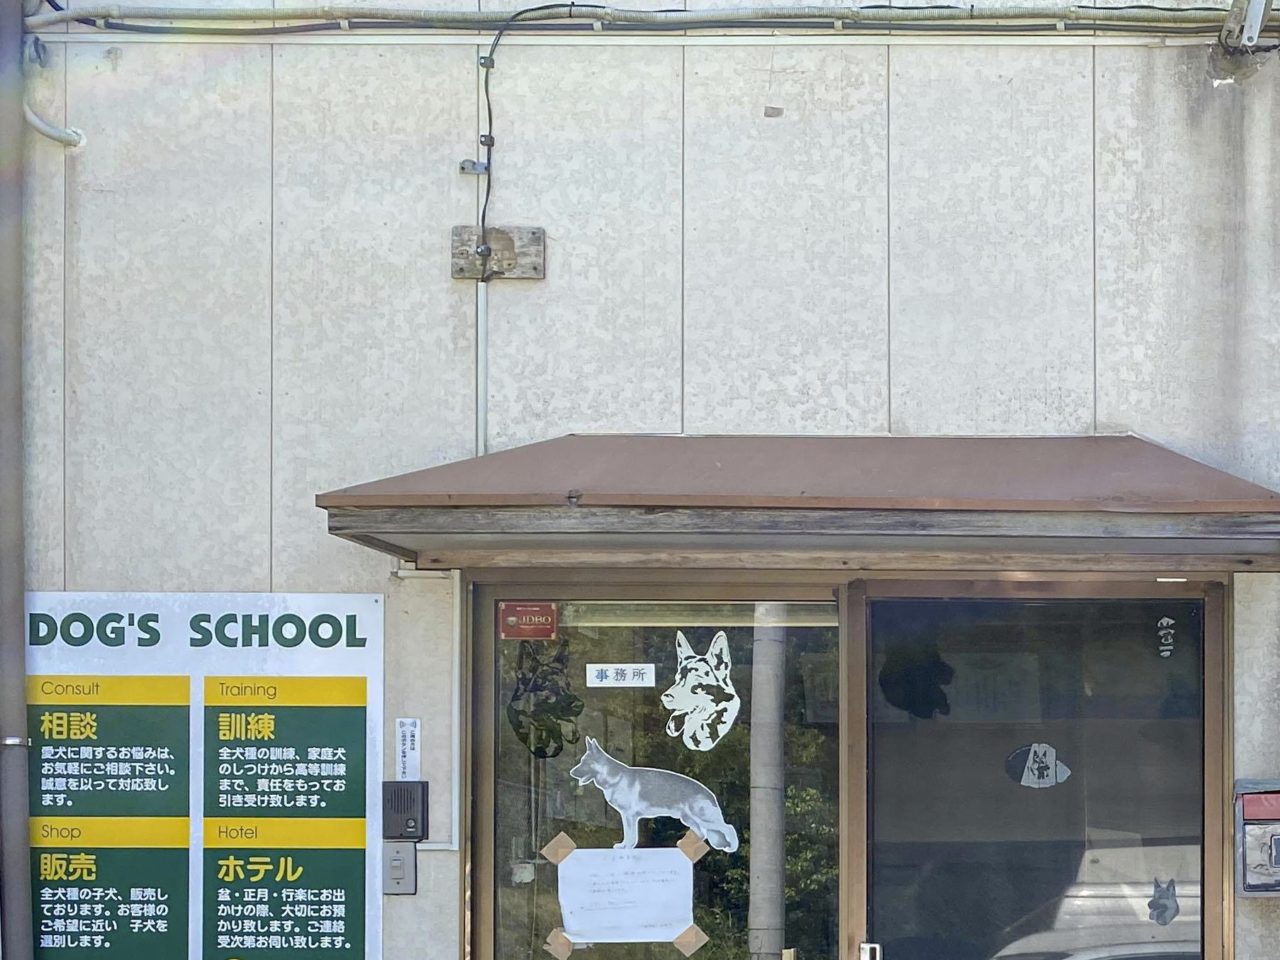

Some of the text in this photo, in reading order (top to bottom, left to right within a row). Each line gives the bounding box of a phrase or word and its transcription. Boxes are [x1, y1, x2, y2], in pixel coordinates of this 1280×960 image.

[29, 613, 367, 648] DOG'S SCHOOL
[595, 668, 647, 682] 事務所
[41, 681, 100, 696] Consult
[219, 682, 277, 699] Training
[41, 712, 98, 740] 相談
[218, 712, 275, 741] 訓練
[41, 747, 175, 760] 愛犬に関するお悩みは、
[219, 747, 346, 760] 全犬種の訓練、家庭犬
[41, 762, 176, 776] お気軽にご相談下さい。
[219, 763, 346, 776] のしつけから高等訓練
[41, 778, 169, 791] 誠意を以って対応致し
[219, 778, 346, 792] まで、責任をもってお
[41, 794, 73, 806] ます。
[219, 795, 327, 808] 引き受け致します。
[41, 825, 81, 840] Shop
[218, 825, 258, 839] Hotel
[39, 853, 97, 881] 販売
[217, 856, 303, 882] ホテル
[40, 888, 168, 901] 全犬種の子犬、販売し
[217, 888, 345, 901] 盆・正月・行楽にお出
[40, 904, 168, 917] ております。お客様の
[217, 904, 345, 917] かけの際、大切にお預
[40, 919, 168, 932] ご希望に近い 子犬を
[217, 919, 345, 933] かり致します。ご連絡
[40, 935, 112, 948] 選別します。
[217, 935, 352, 949] 受次第お伺い致します。
